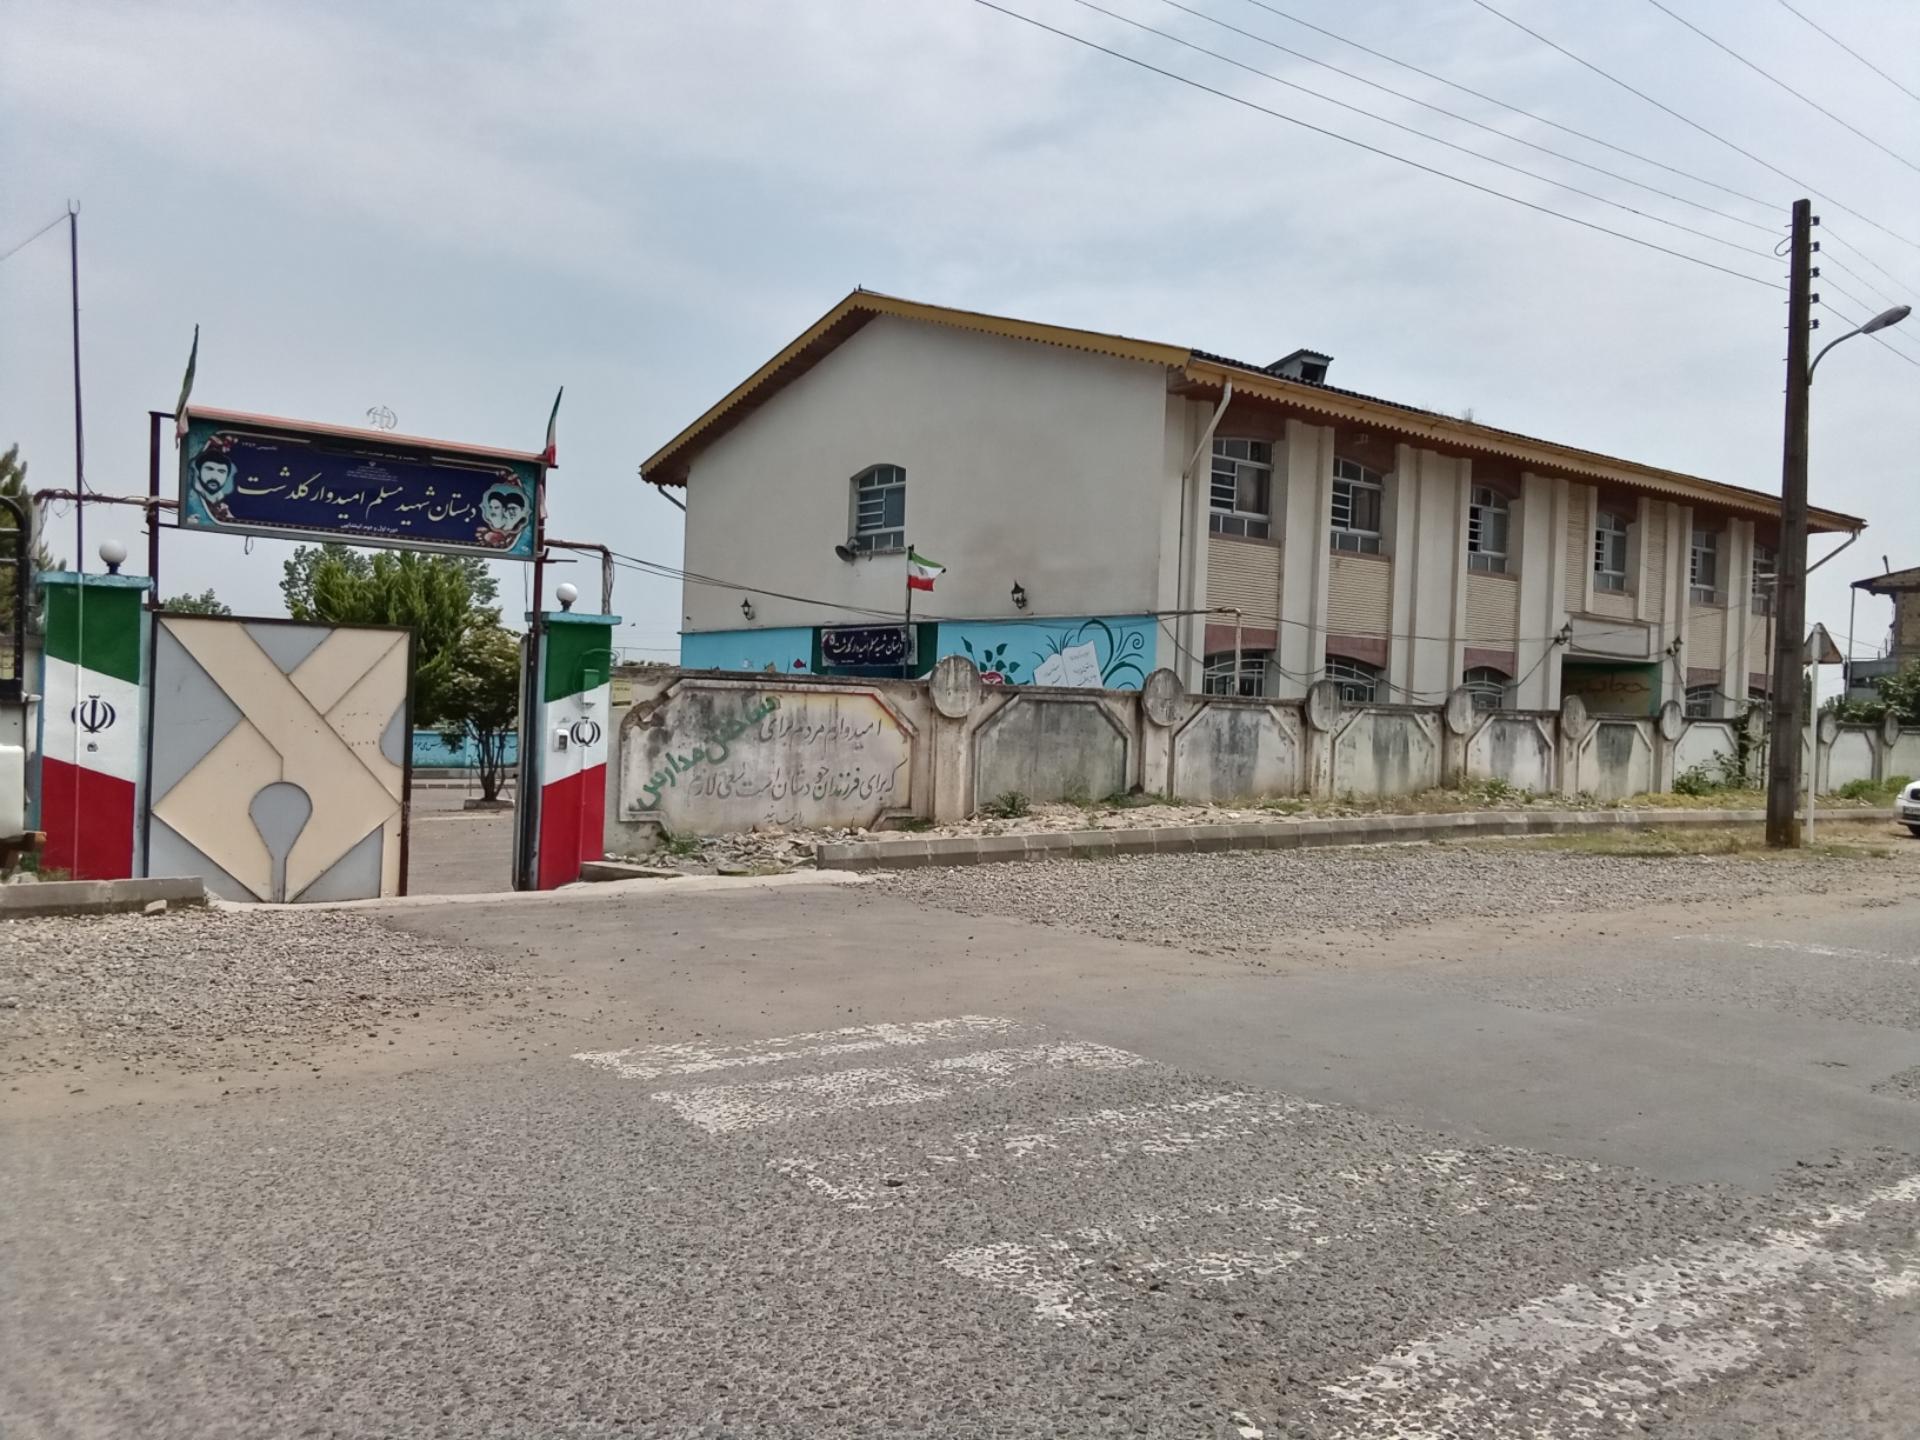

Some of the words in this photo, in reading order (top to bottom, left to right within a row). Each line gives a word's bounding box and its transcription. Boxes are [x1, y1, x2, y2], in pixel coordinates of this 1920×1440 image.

[309, 485, 365, 520] امیدوار
[365, 486, 404, 521] مسلم
[394, 485, 435, 526] شهید
[427, 493, 477, 523] دبستان
[812, 767, 861, 801] فرزندان
[859, 773, 888, 801] برای
